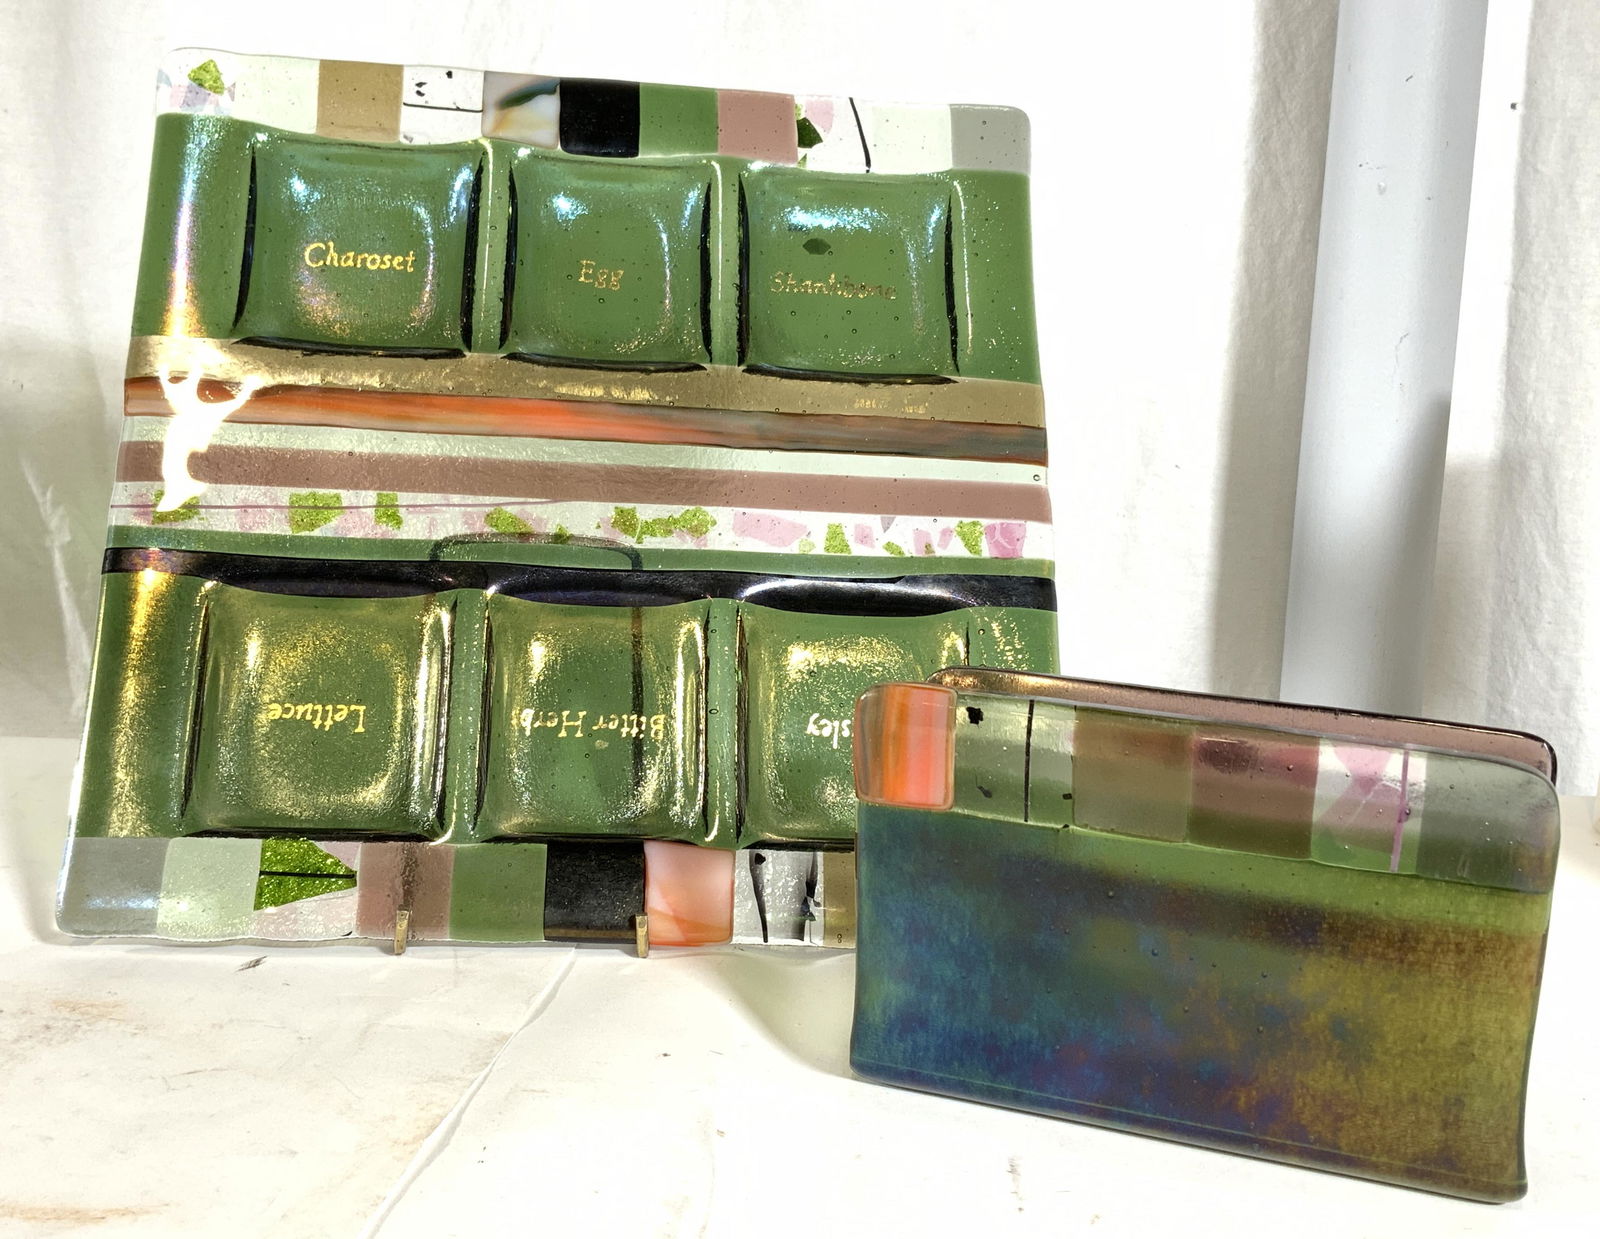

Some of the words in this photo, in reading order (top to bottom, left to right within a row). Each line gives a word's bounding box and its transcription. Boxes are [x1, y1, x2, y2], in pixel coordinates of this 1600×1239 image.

[304, 241, 416, 272] Charoset
[578, 259, 624, 291] Egg
[267, 703, 366, 733] Lettuce
[592, 713, 666, 740] Bitter
[806, 712, 852, 749] sley
